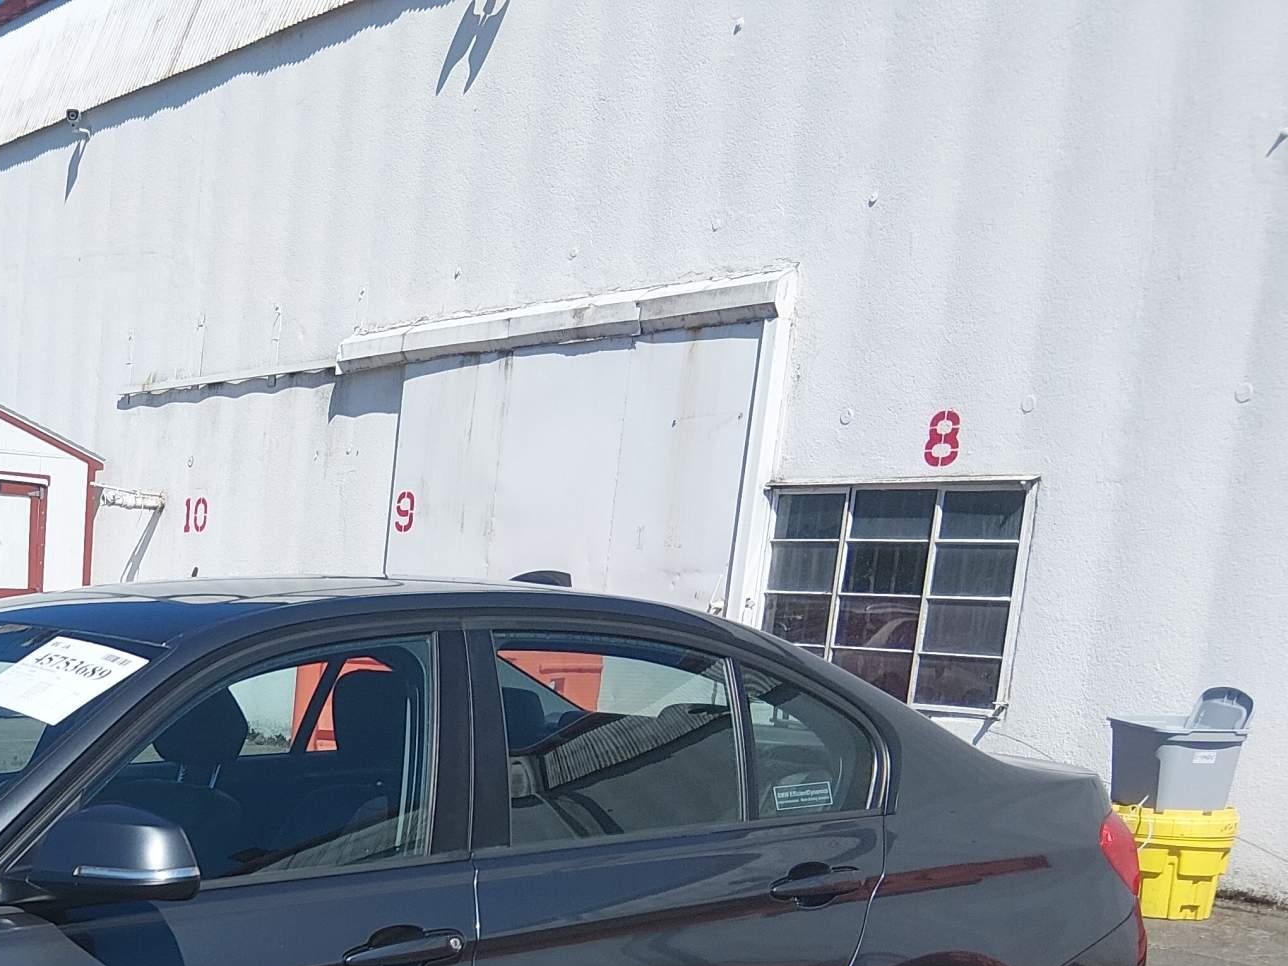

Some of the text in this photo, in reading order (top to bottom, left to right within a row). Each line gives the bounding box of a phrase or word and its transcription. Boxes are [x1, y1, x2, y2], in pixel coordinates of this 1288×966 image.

[924, 410, 960, 467] 8
[183, 497, 208, 532] 10
[394, 491, 414, 532] 9
[35, 653, 112, 680] 45753689
